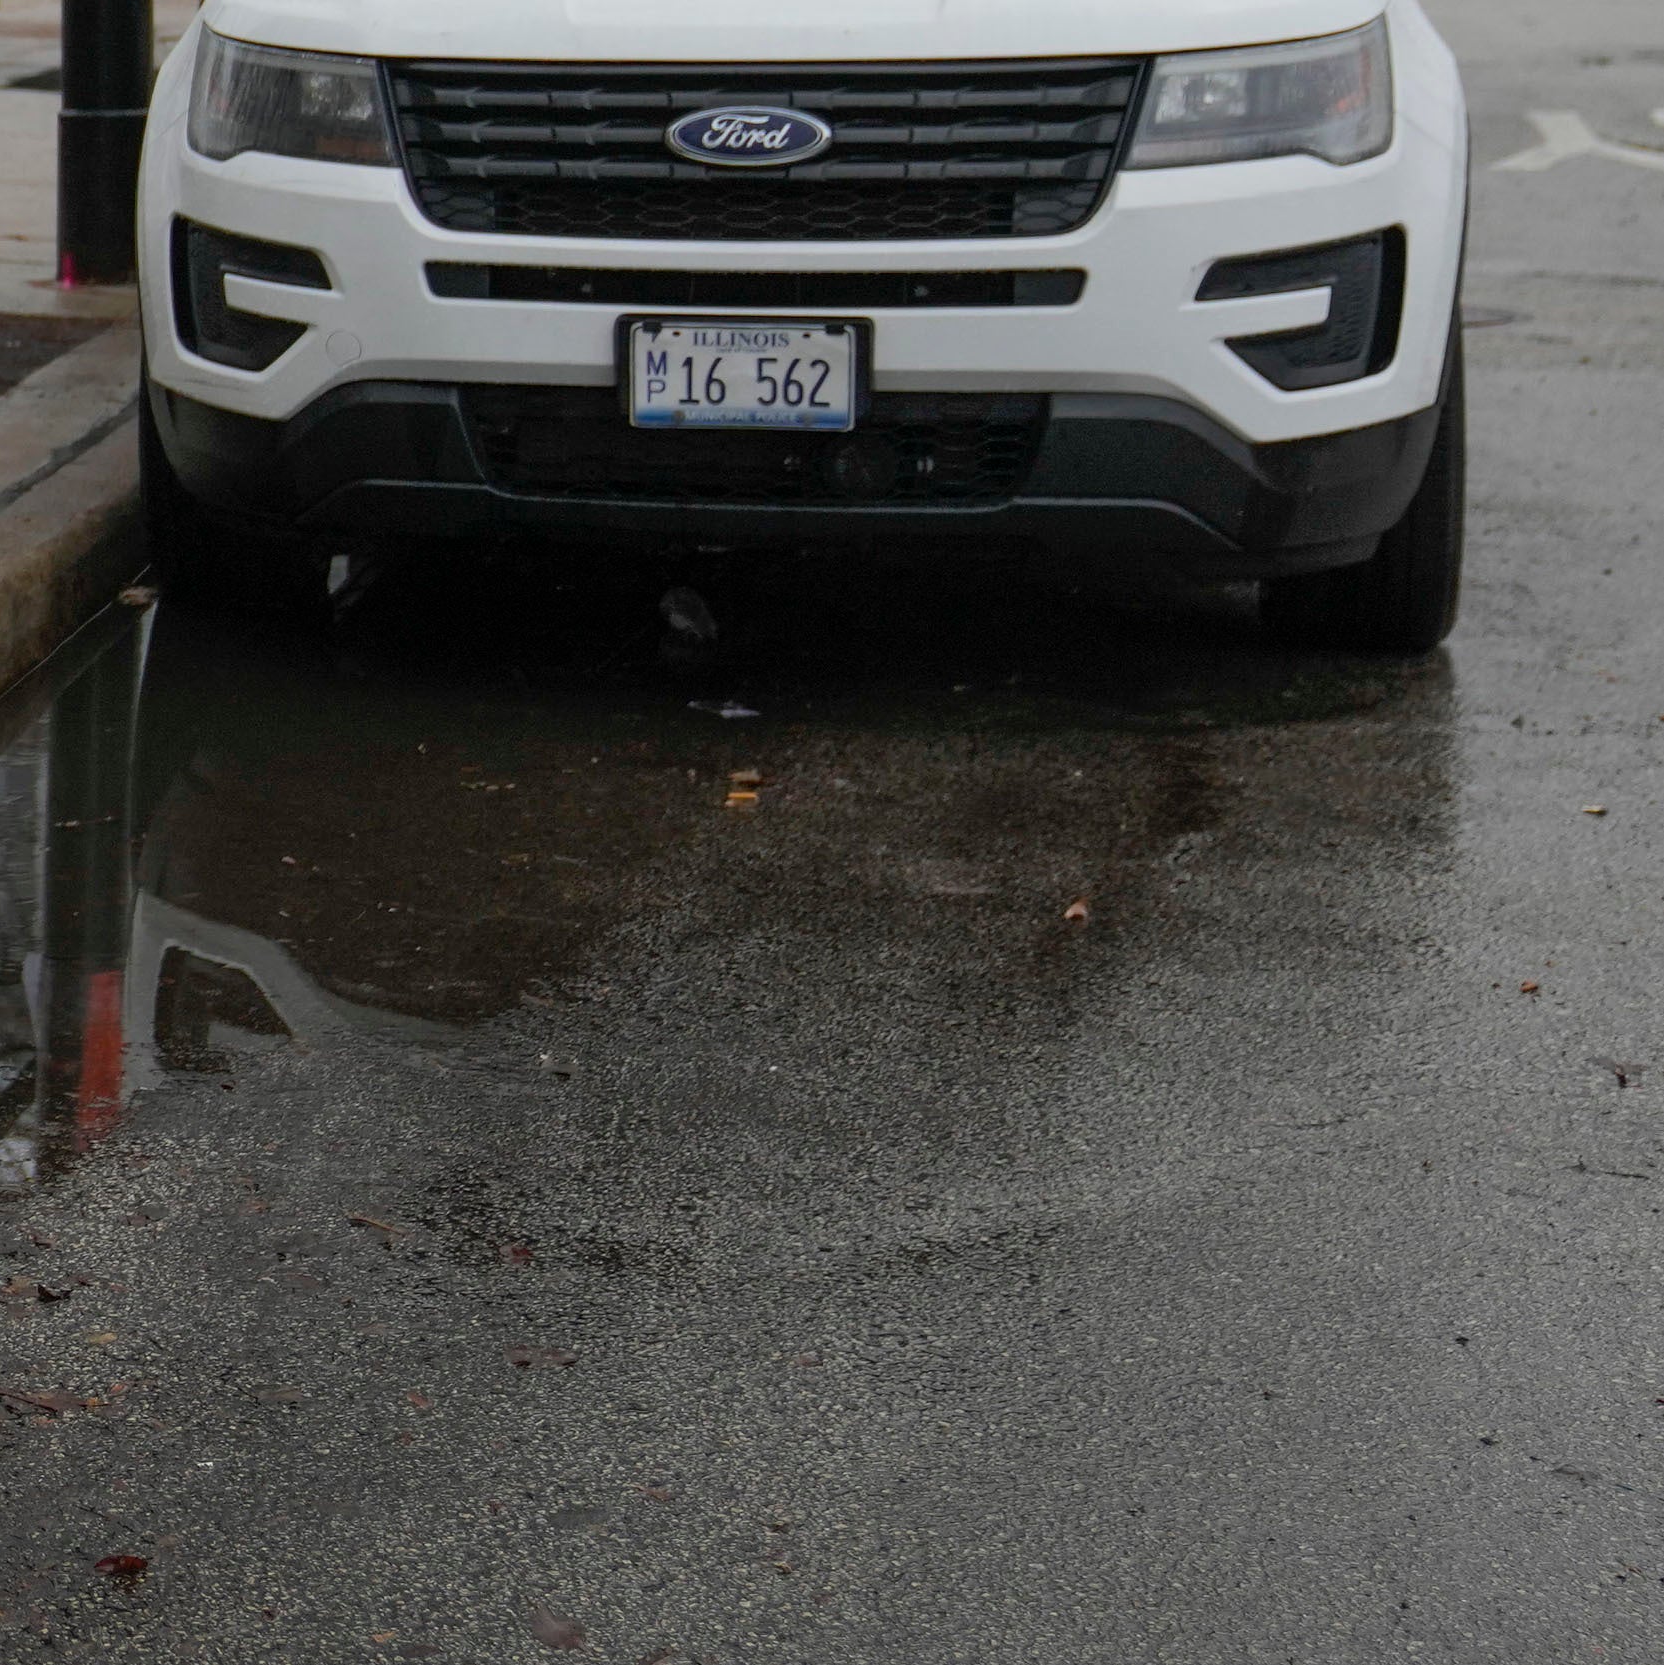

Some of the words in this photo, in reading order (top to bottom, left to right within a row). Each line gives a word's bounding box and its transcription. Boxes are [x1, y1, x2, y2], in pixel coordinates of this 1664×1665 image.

[701, 112, 792, 149] Ford
[692, 331, 790, 348] ILLINOIS
[679, 356, 727, 405] 16
[756, 357, 831, 408] 562
